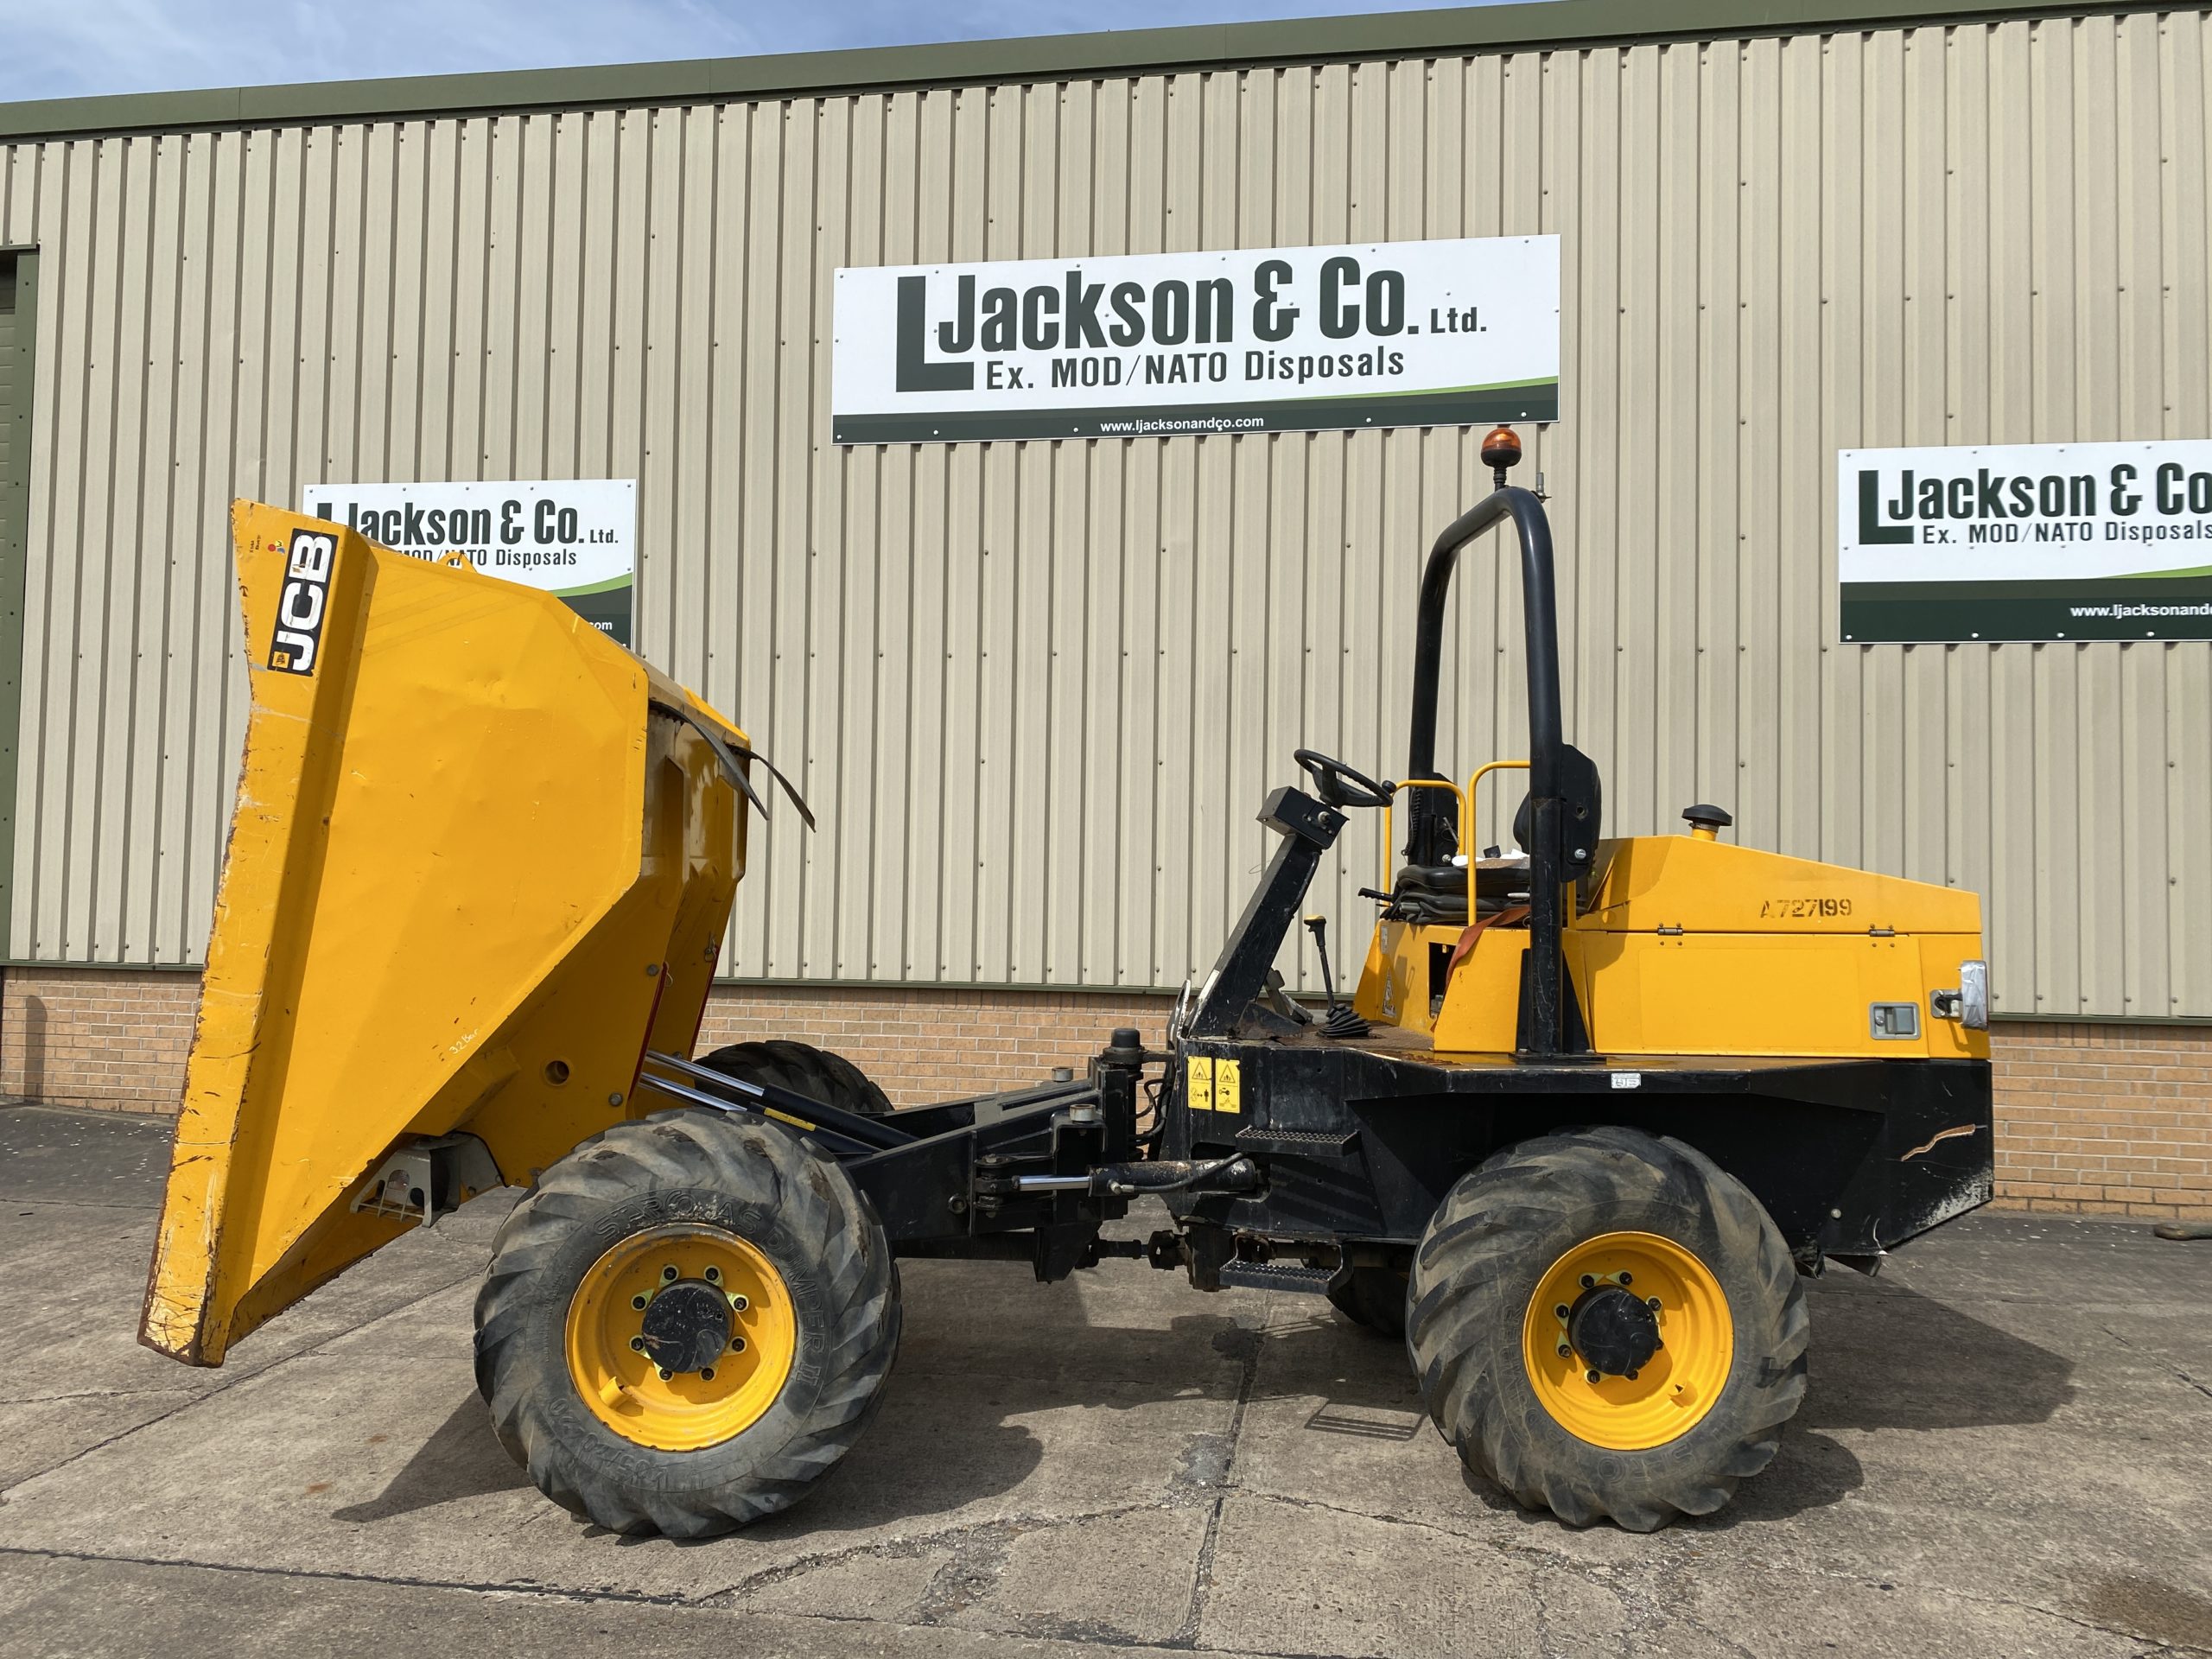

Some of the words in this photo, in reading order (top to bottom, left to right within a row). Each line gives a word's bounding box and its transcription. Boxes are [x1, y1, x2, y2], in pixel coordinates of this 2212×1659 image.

[1253, 260, 1300, 341] &
[1319, 257, 1420, 339] Co.
[1431, 308, 1487, 333] Ltd.
[987, 361, 1033, 390] Ex.
[1052, 353, 1227, 387] MOD/NATO
[1246, 346, 1404, 385] Disposals
[1100, 417, 1264, 434] www.ljacksonandco.com
[2111, 464, 2143, 517] &
[317, 503, 492, 546] ackson
[500, 499, 524, 545] &
[535, 499, 585, 544] Co.
[590, 529, 619, 543] Ltd.
[1923, 524, 1956, 544] Ex.
[1969, 522, 2093, 543] MOD/NATO
[2106, 520, 2212, 544] Disposals
[496, 549, 576, 569] Disposals
[276, 533, 333, 671] JCB
[1760, 899, 1853, 918] A727199
